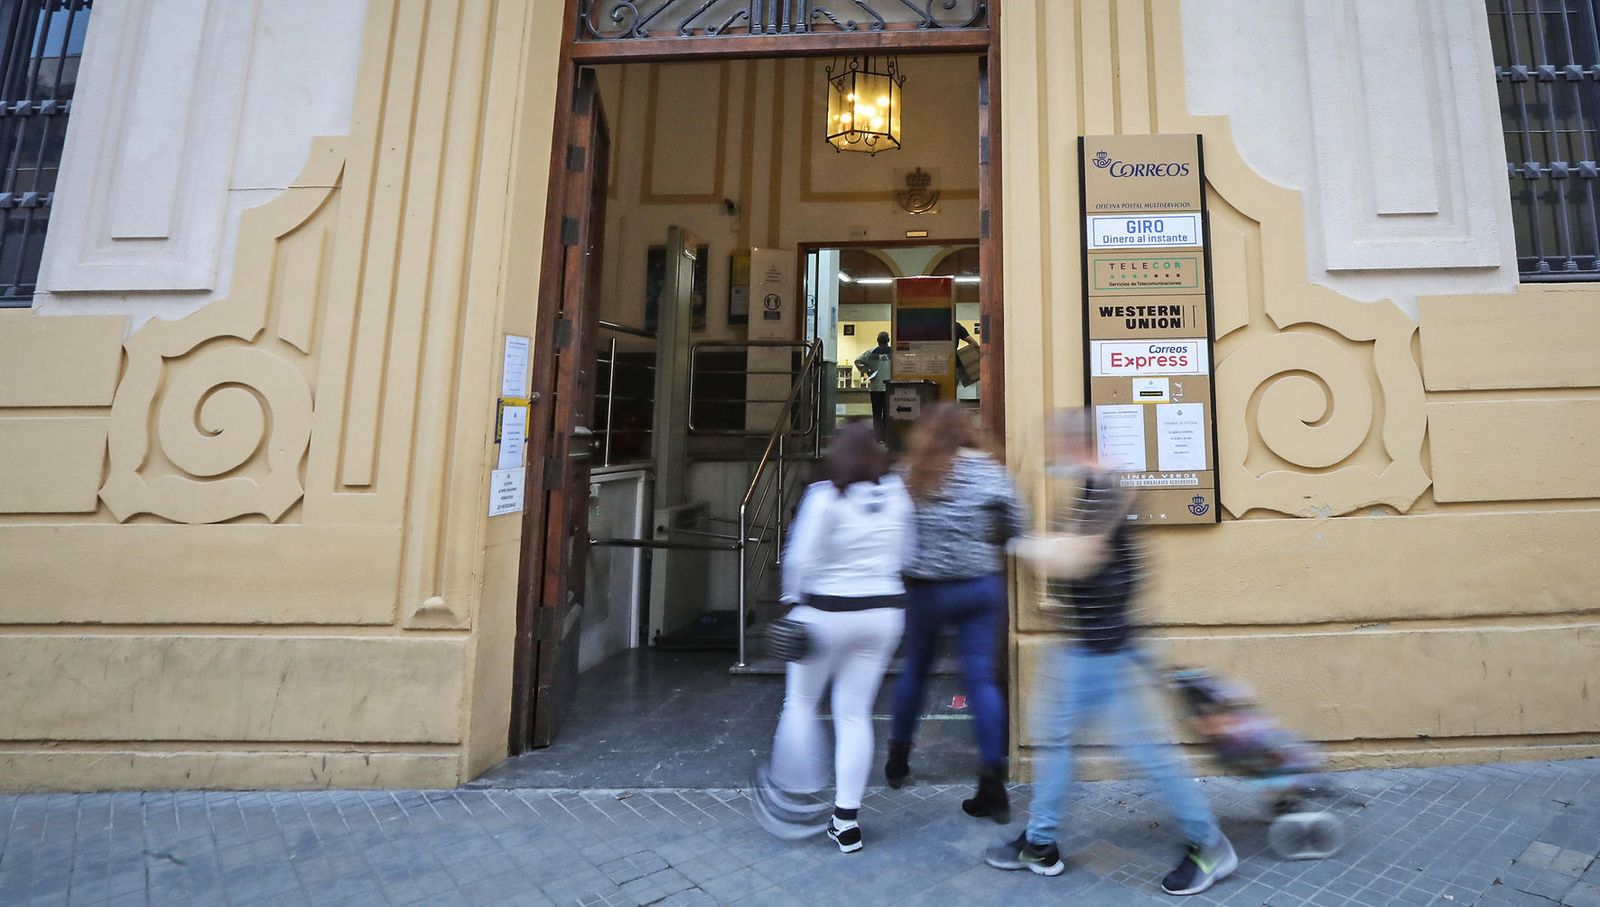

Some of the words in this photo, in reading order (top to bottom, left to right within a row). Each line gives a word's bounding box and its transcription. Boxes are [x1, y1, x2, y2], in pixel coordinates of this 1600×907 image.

[1110, 161, 1190, 178] CORREOS
[1126, 219, 1164, 234] GIRO
[1102, 235, 1135, 244] Dinero
[1137, 234, 1146, 243] al
[1148, 234, 1188, 243] instante
[1109, 261, 1182, 270] TELECOR
[1099, 305, 1181, 317] WESTERN
[1125, 318, 1181, 329] UNION
[1148, 344, 1188, 354] Correos
[1111, 352, 1188, 370] Express
